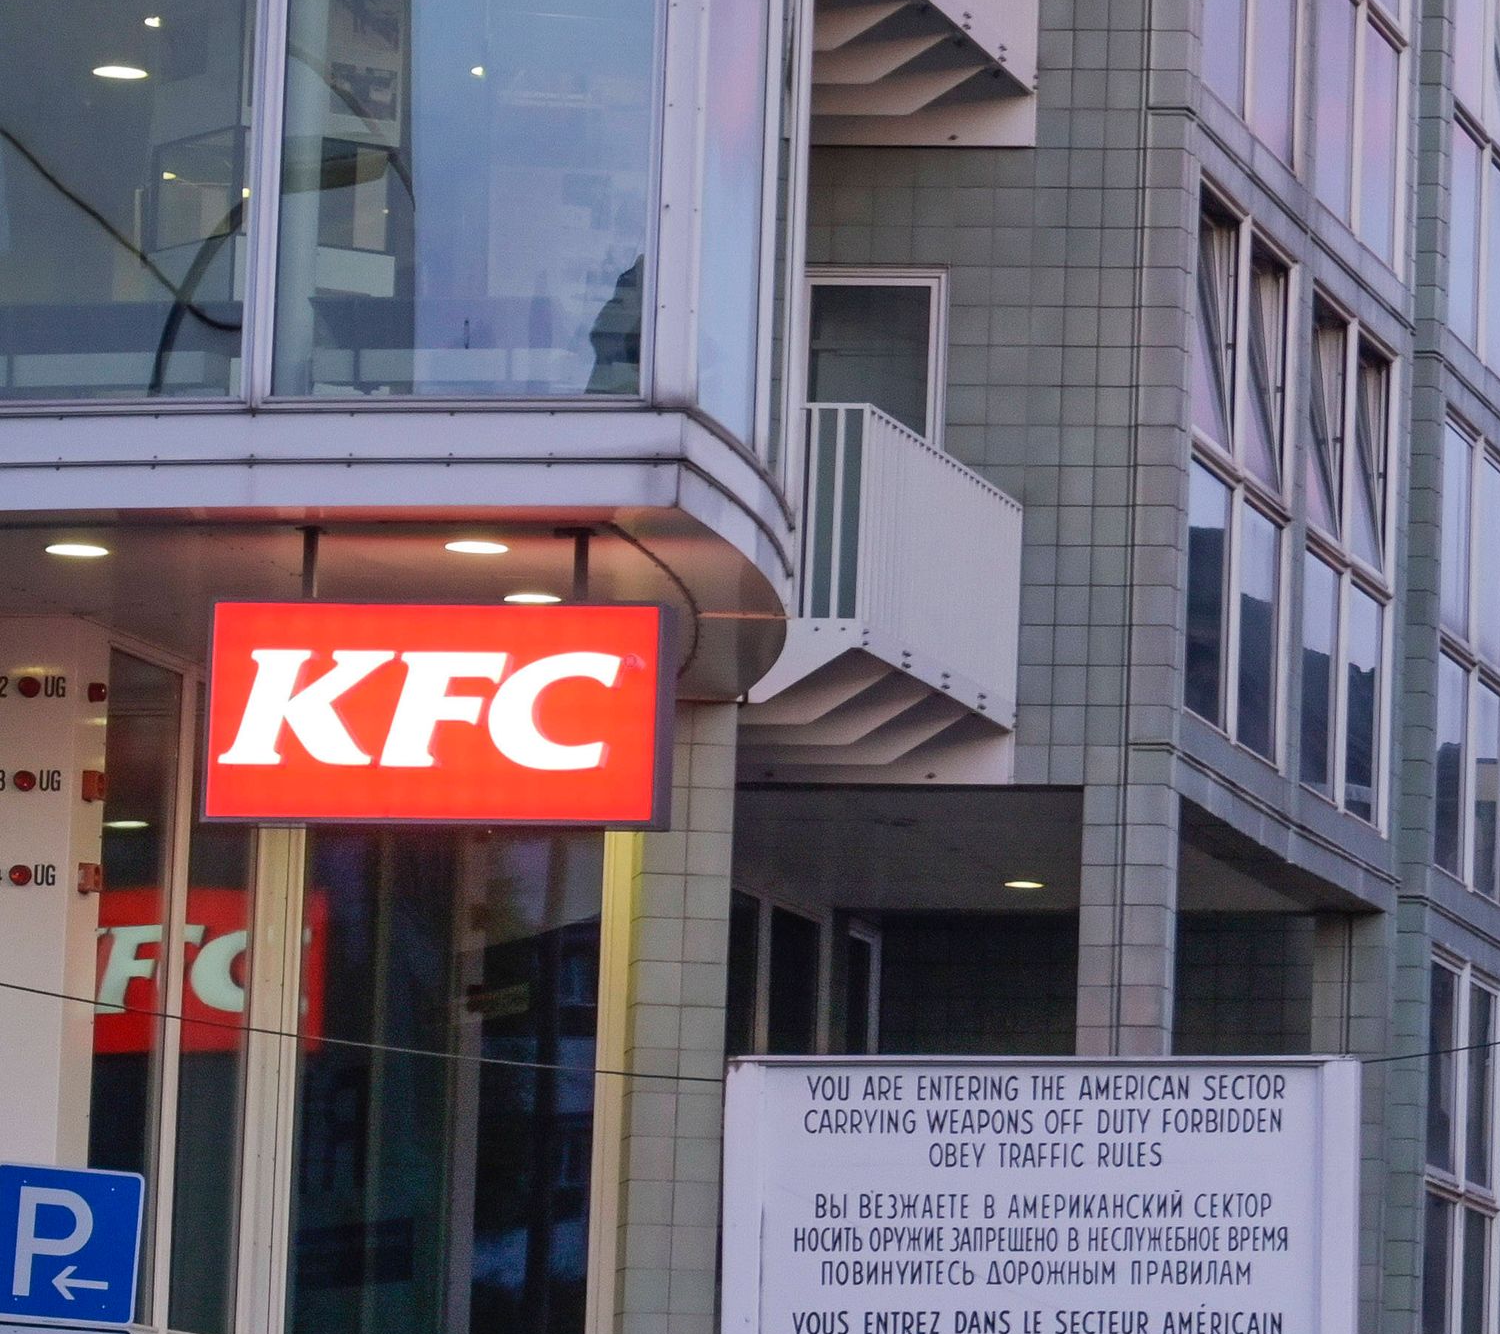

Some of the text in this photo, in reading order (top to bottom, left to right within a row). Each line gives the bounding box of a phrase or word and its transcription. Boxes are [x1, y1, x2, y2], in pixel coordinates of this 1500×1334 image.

[44, 676, 66, 698] UG
[217, 648, 622, 771] KFC
[39, 770, 61, 792] UG
[34, 864, 56, 886] UG
[806, 1073, 1286, 1102] YOU ARE ENTERING THE AMERICAN SECTOR
[804, 1107, 1282, 1135] CARRYING WEAPONS OFF DUTY FORBIDDEN
[928, 1141, 1163, 1169] OBEY TRAFFIC RULES
[814, 1189, 1272, 1220] ВЫ В АМЕРИКАНСКИЙ СЕКТОР
[793, 1226, 864, 1253] НОСИТЬ
[869, 1226, 944, 1253] ОРУЖИЕ
[1067, 1226, 1080, 1253] В
[1087, 1225, 1220, 1252] НЕСЛУЖЕБНОЕ
[1228, 1225, 1289, 1252] ВРЕМЯ
[986, 1259, 1116, 1286] ДОРОЖНЫМ
[1131, 1259, 1252, 1286] ПРАВИЛАМ
[1023, 1310, 1042, 1334] LE
